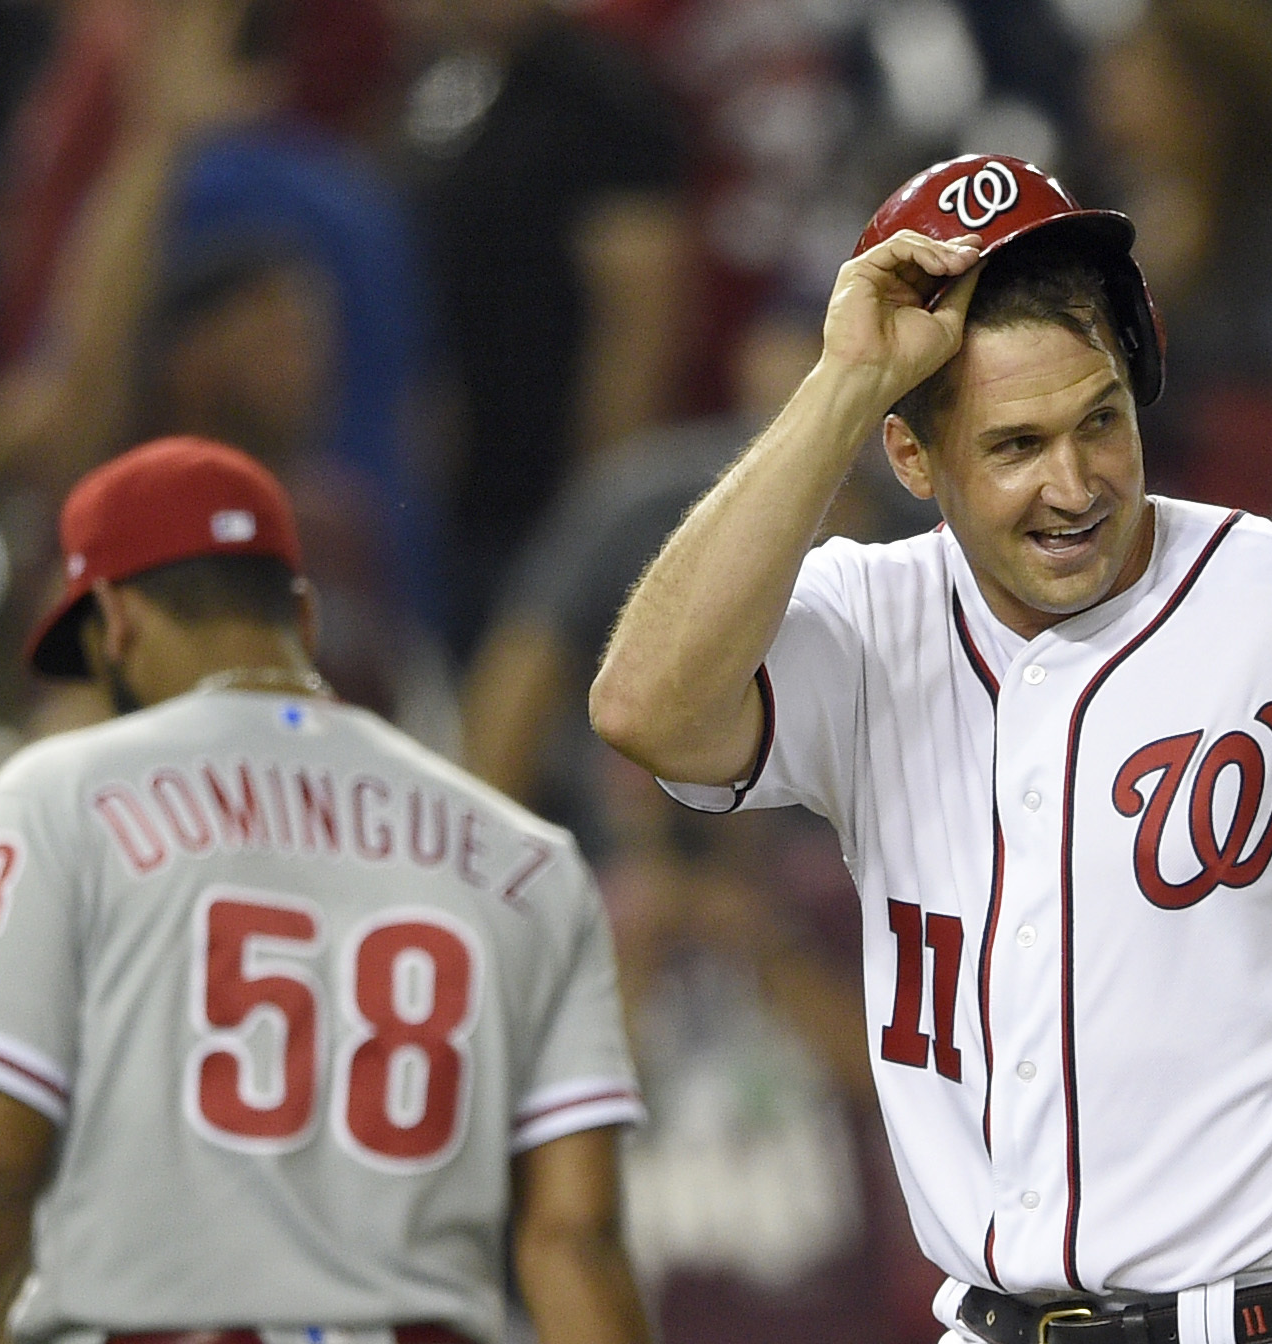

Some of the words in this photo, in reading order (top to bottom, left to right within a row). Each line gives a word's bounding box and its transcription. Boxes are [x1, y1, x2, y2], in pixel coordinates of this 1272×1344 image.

[937, 161, 1020, 229] W
[92, 761, 563, 914] DOMINGUEZ
[184, 882, 483, 1175] 58
[881, 898, 963, 1083] 11
[1242, 1305, 1267, 1336] 11
